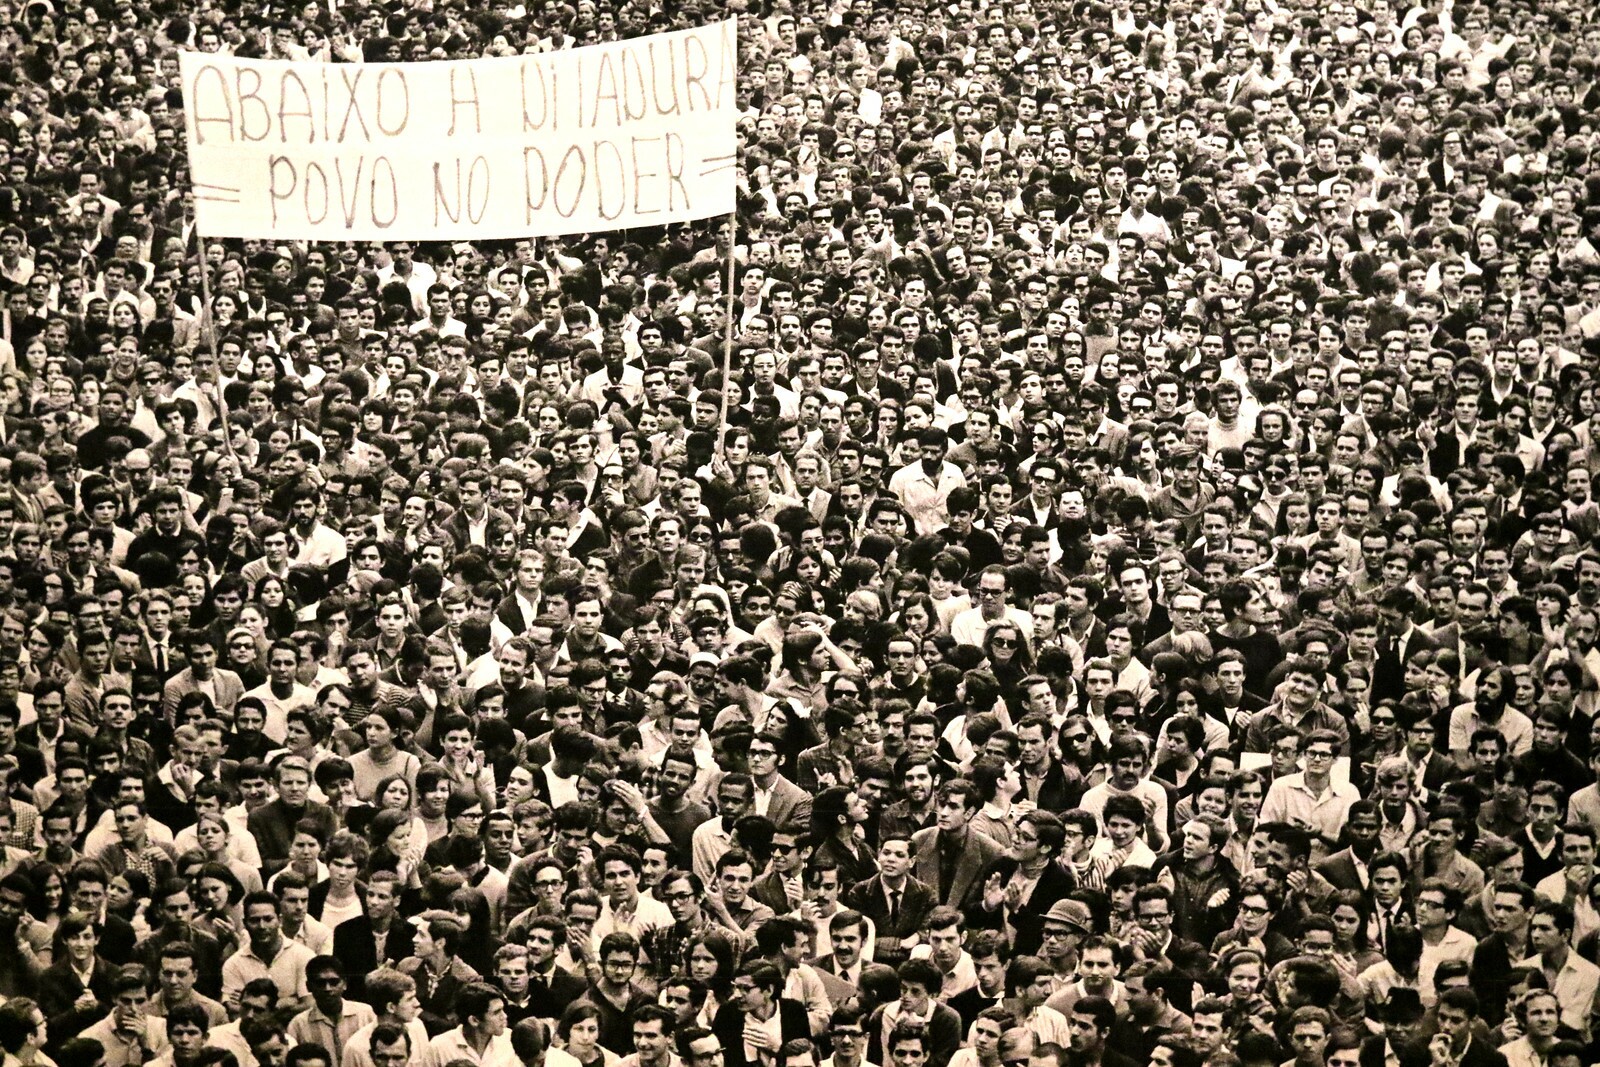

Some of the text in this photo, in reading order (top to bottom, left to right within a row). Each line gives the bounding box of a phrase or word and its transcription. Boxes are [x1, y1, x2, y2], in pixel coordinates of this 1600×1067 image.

[269, 154, 398, 229] POVO
[432, 155, 490, 228] NO
[523, 132, 691, 226] PODER
